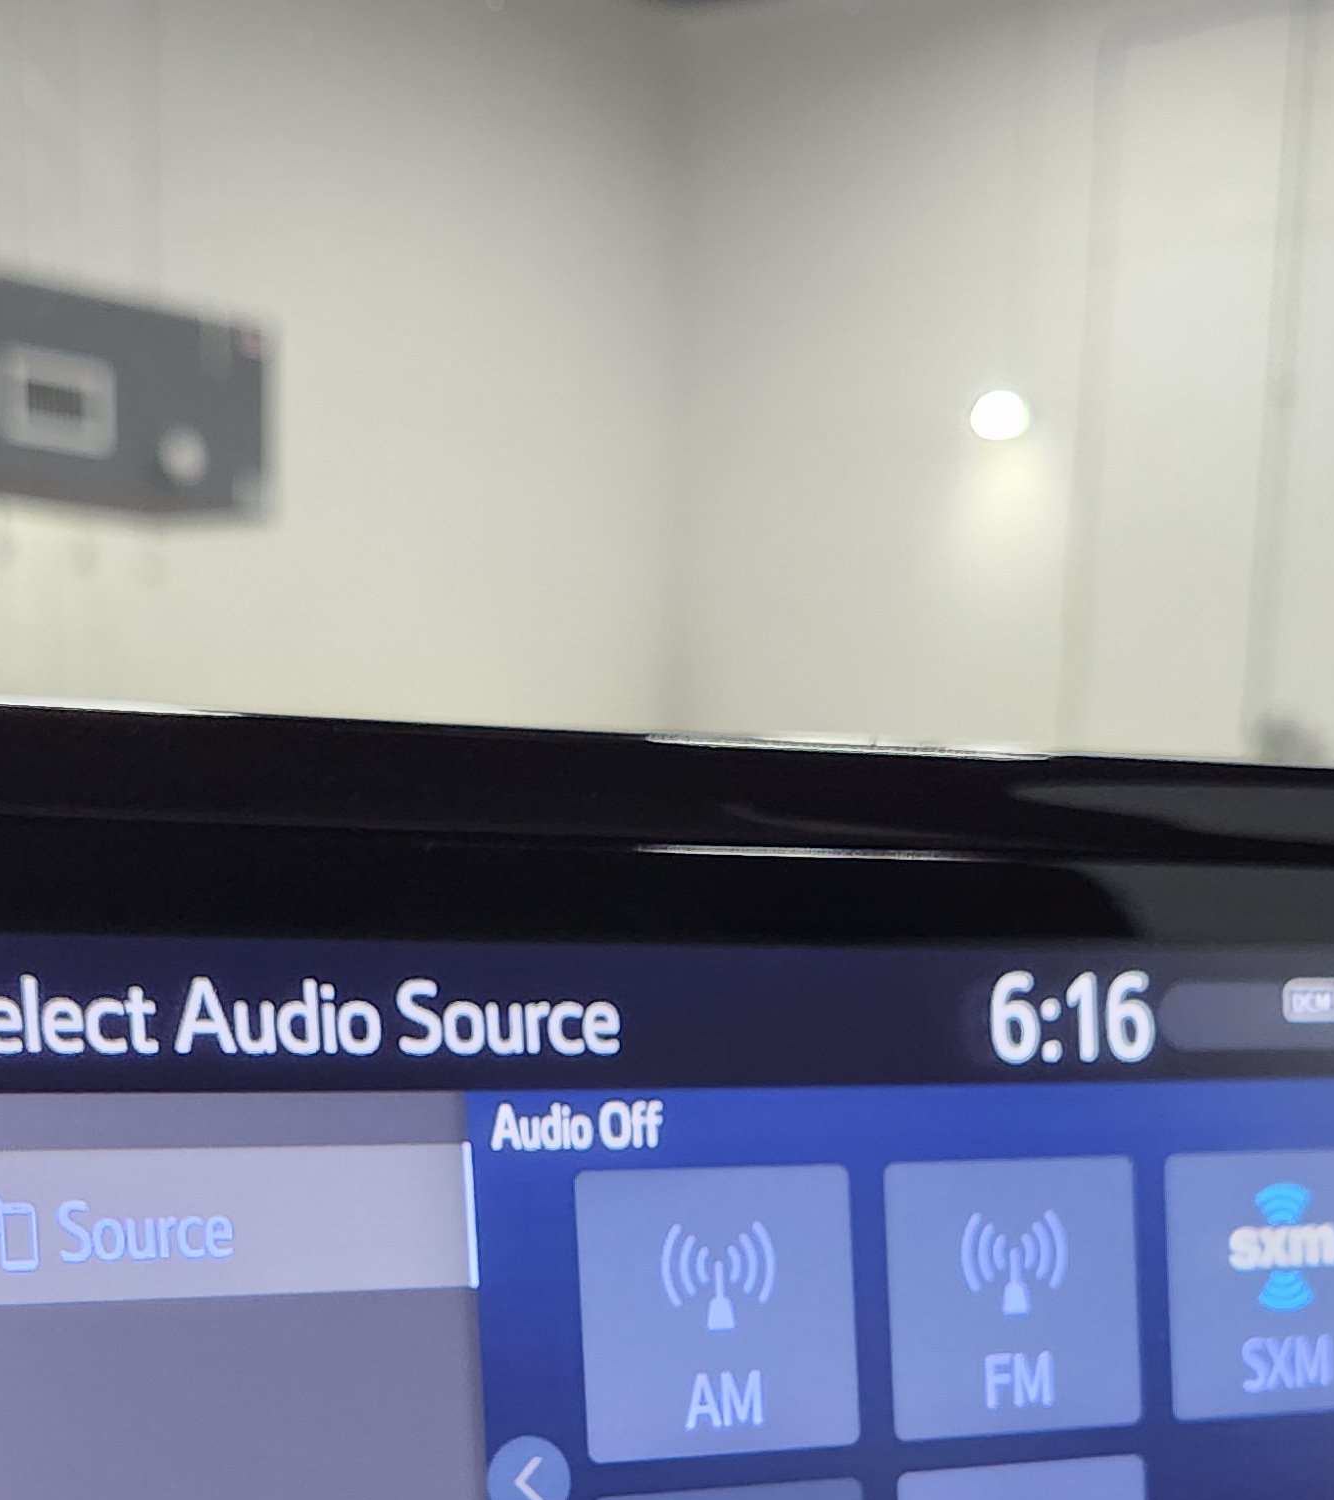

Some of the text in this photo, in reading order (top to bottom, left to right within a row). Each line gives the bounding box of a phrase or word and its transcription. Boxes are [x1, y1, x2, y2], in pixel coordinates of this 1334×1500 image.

[174, 976, 382, 1055] Audio
[395, 979, 621, 1055] Source
[989, 969, 1156, 1065] 6:16
[490, 1099, 664, 1152] Audio Off
[59, 1200, 234, 1263] Source
[983, 1350, 1056, 1410] FM
[1241, 1334, 1334, 1392] SXM
[684, 1369, 765, 1430] AM
